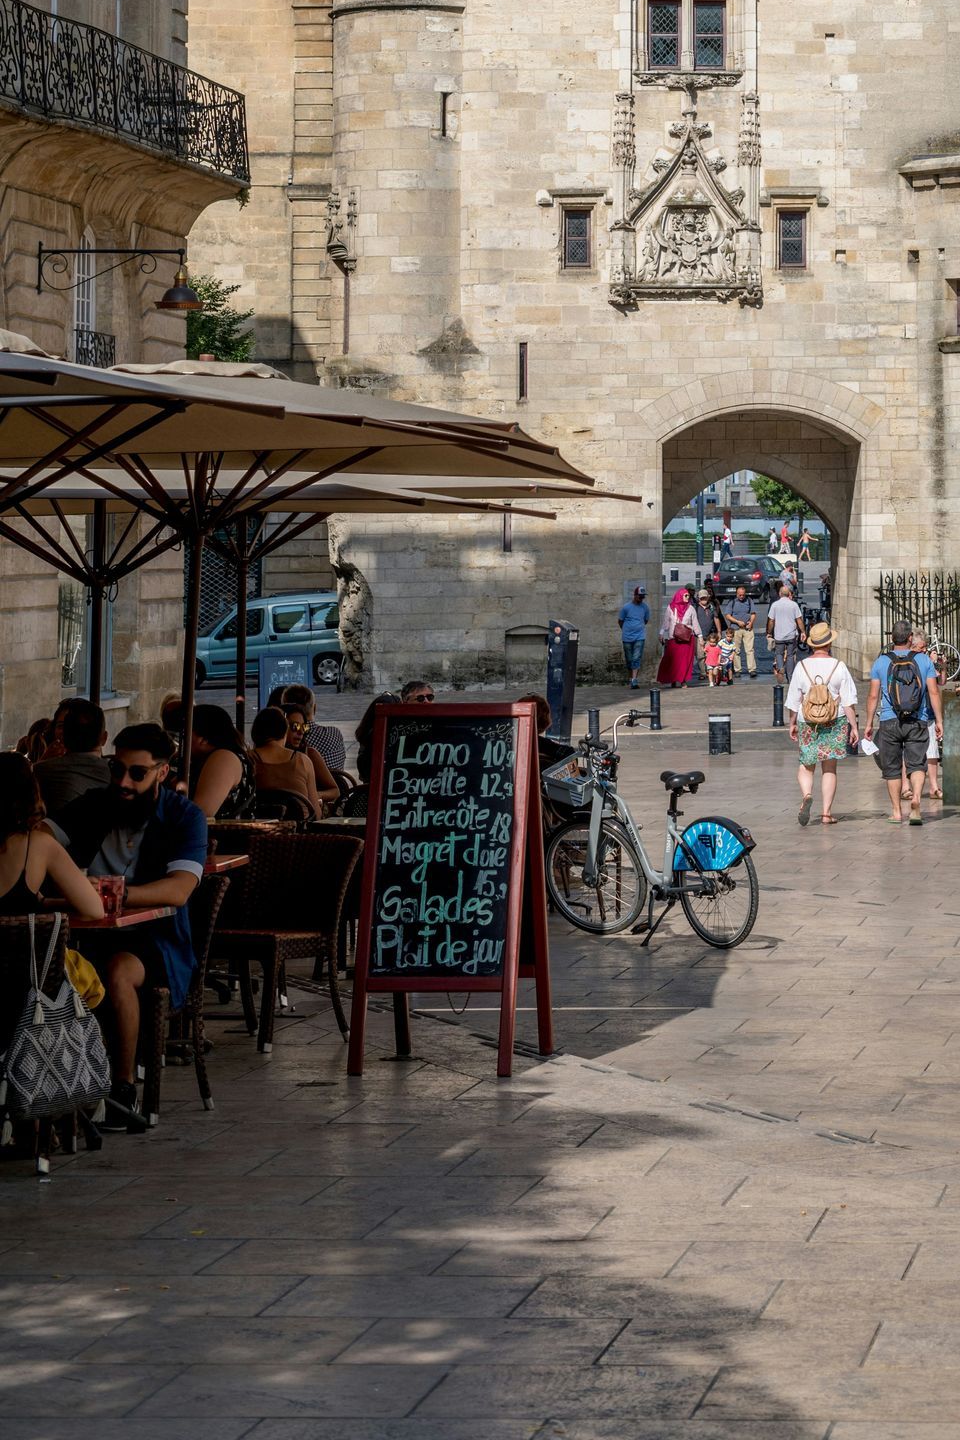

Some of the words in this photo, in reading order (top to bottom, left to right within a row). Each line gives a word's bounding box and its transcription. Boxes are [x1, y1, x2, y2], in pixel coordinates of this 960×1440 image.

[396, 735, 471, 767] Lomo
[387, 767, 467, 796] Bavette
[385, 796, 490, 830] Entrecôte
[489, 811, 512, 844] 18
[381, 831, 468, 884] Magret
[379, 870, 494, 926] Salades
[436, 924, 468, 967] de
